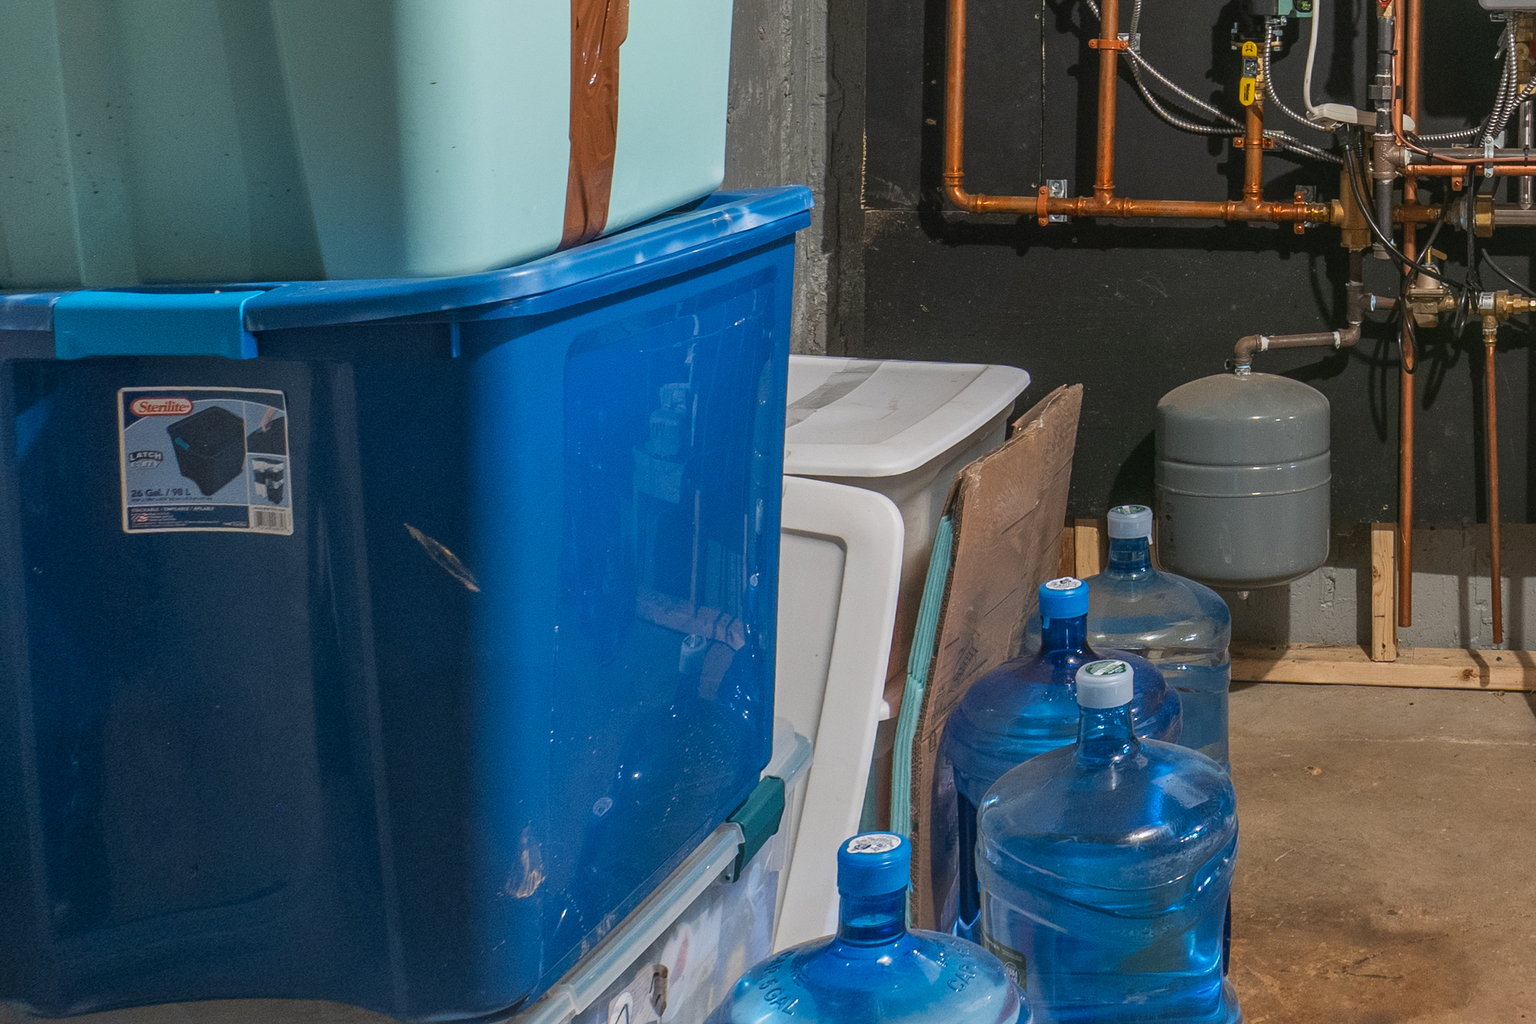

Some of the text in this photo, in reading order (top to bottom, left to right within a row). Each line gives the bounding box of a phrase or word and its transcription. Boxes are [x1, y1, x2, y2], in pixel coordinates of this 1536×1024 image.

[139, 400, 190, 413] Sterilite
[130, 451, 163, 462] LATCH
[947, 964, 977, 994] CAP
[764, 988, 799, 1016] GAL
